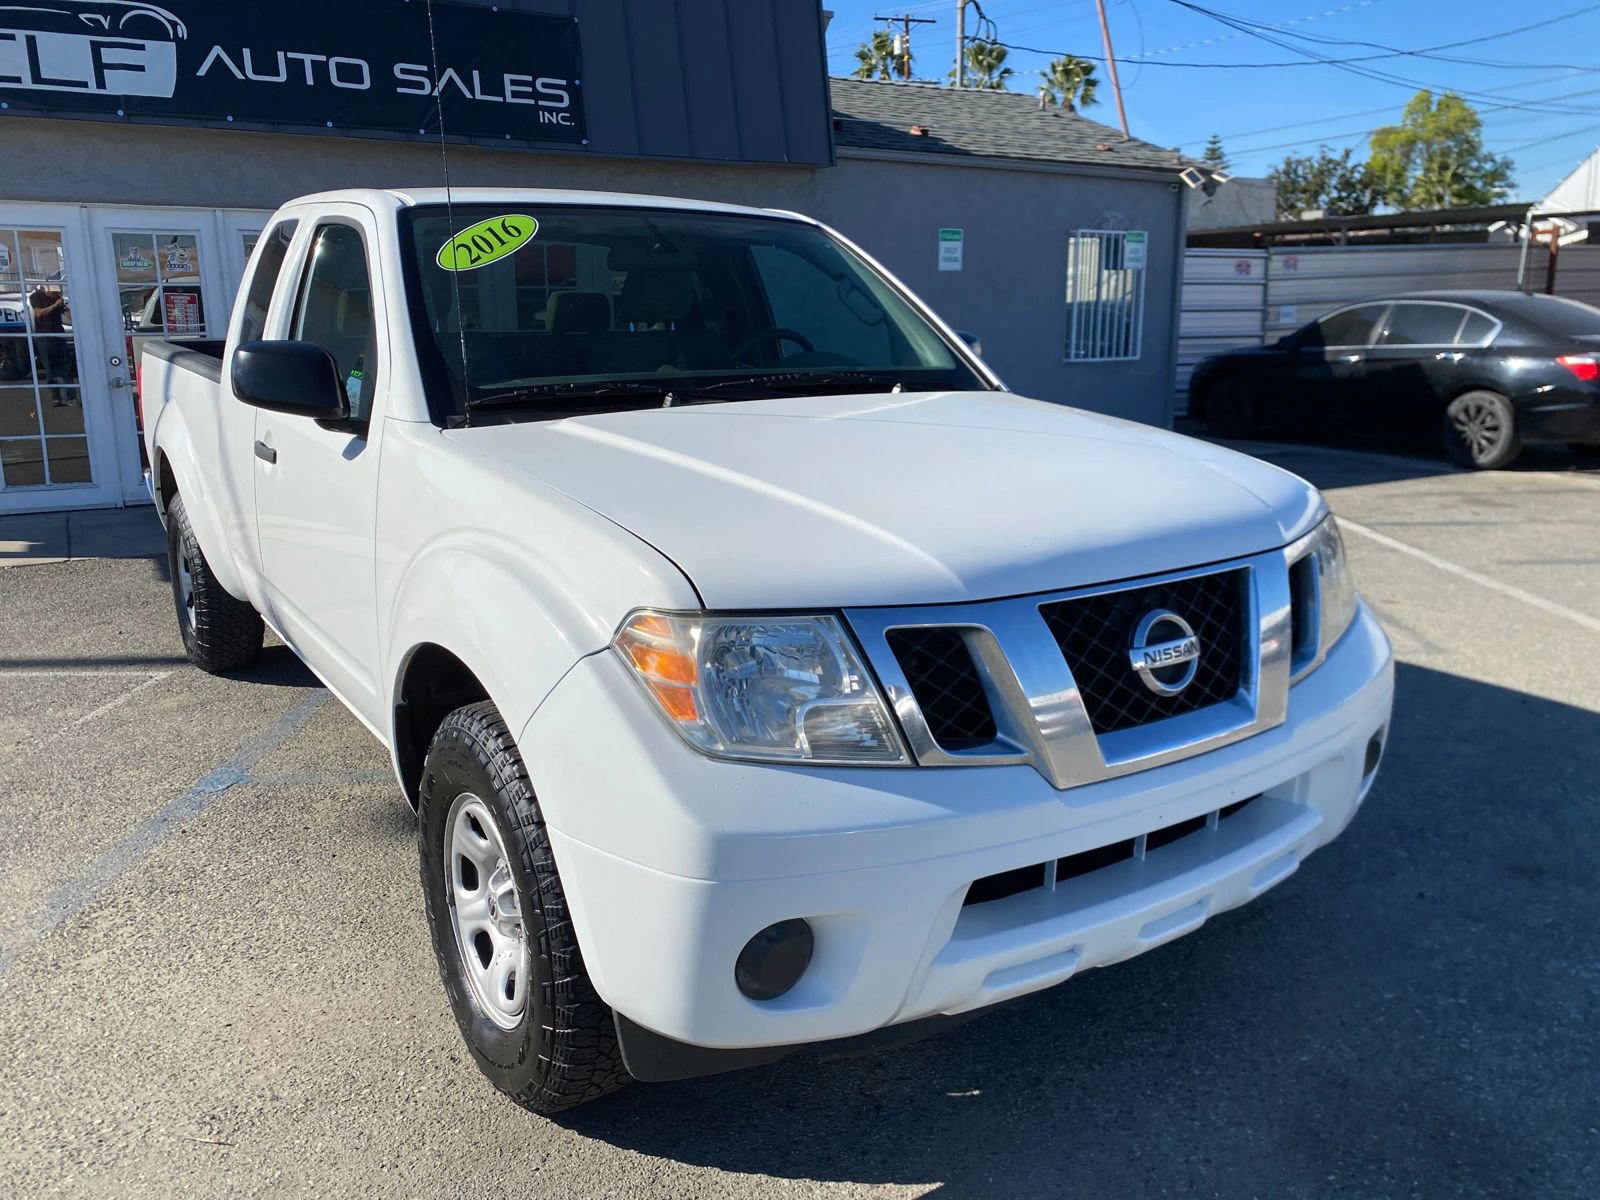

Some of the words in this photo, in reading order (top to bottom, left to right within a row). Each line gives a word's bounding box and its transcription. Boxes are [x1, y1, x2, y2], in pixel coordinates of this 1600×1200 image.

[195, 44, 371, 90] AUTO
[393, 62, 570, 108] SALES
[538, 110, 575, 126] INC.
[455, 218, 522, 265] 2016
[1143, 639, 1199, 664] NISSAN
